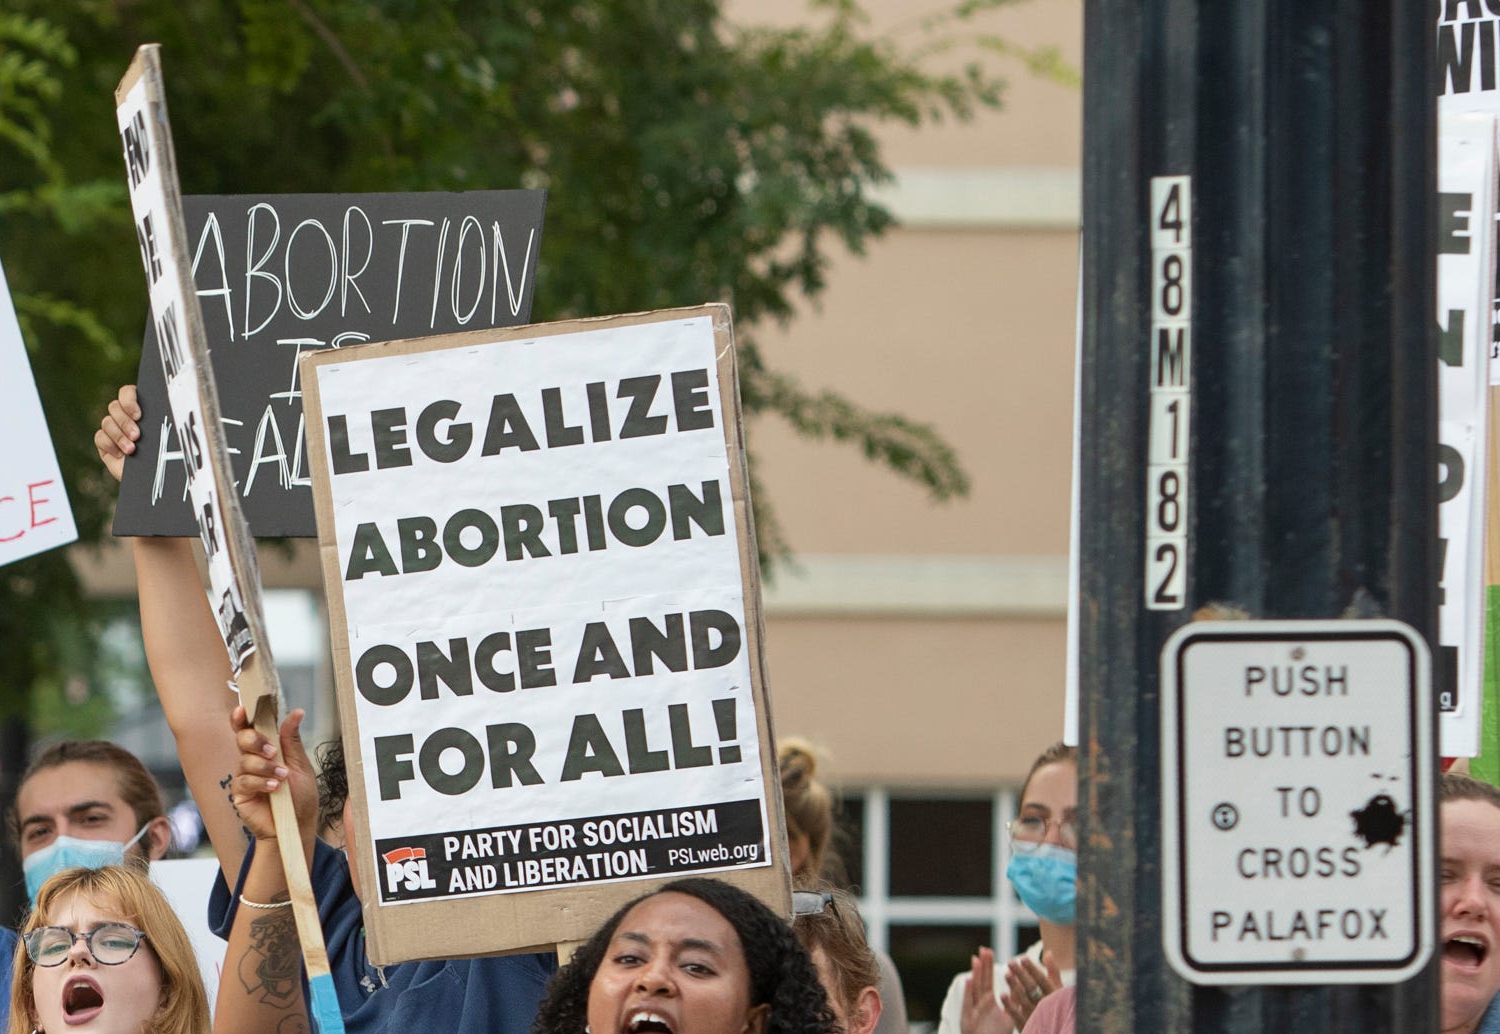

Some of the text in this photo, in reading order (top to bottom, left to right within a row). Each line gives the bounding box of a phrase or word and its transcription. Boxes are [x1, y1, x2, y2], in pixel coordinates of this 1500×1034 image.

[191, 203, 535, 341] ABORTION
[270, 332, 370, 405] I
[1154, 182, 1184, 604] 48M182
[327, 368, 714, 475] LEGALIZE
[345, 479, 725, 581] ABORTION
[356, 609, 741, 706] ONCE AND
[1244, 666, 1349, 697] PUSH
[374, 697, 743, 801] FOR ALL!
[1225, 726, 1372, 758] BUTTON
[1275, 786, 1321, 818] TO
[444, 808, 718, 860] PARTY FOR SOCIALISM
[668, 843, 759, 866] PSLweb.org
[385, 860, 437, 892] PSL
[449, 849, 648, 893] AND LIBERATION
[1237, 847, 1362, 879] CROSS
[1211, 909, 1389, 942] PALAFOX
